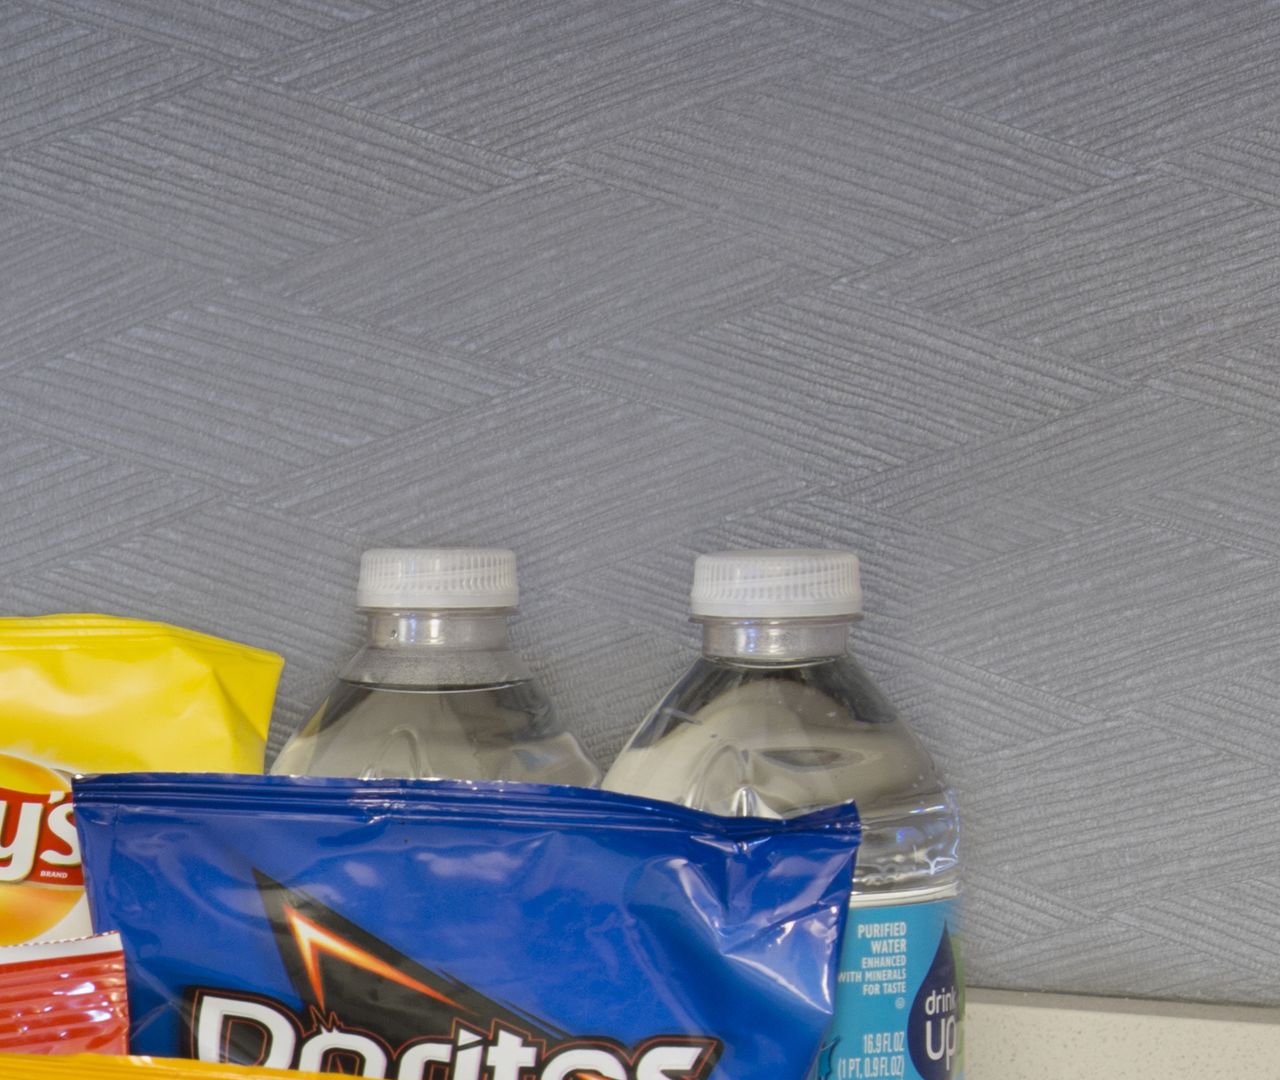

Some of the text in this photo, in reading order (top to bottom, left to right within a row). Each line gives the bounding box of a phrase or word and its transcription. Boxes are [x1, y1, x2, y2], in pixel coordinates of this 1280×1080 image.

[40, 869, 68, 880] BRAND
[858, 922, 907, 938] PURIFIED
[871, 938, 907, 953] WATER
[861, 954, 906, 970] ENHANCED
[864, 968, 907, 982] MINERALS
[863, 983, 906, 996] FOR TASTE
[864, 1034, 881, 1054] 16.9
[893, 1031, 905, 1052] OZ
[864, 1057, 879, 1077] 0.9
